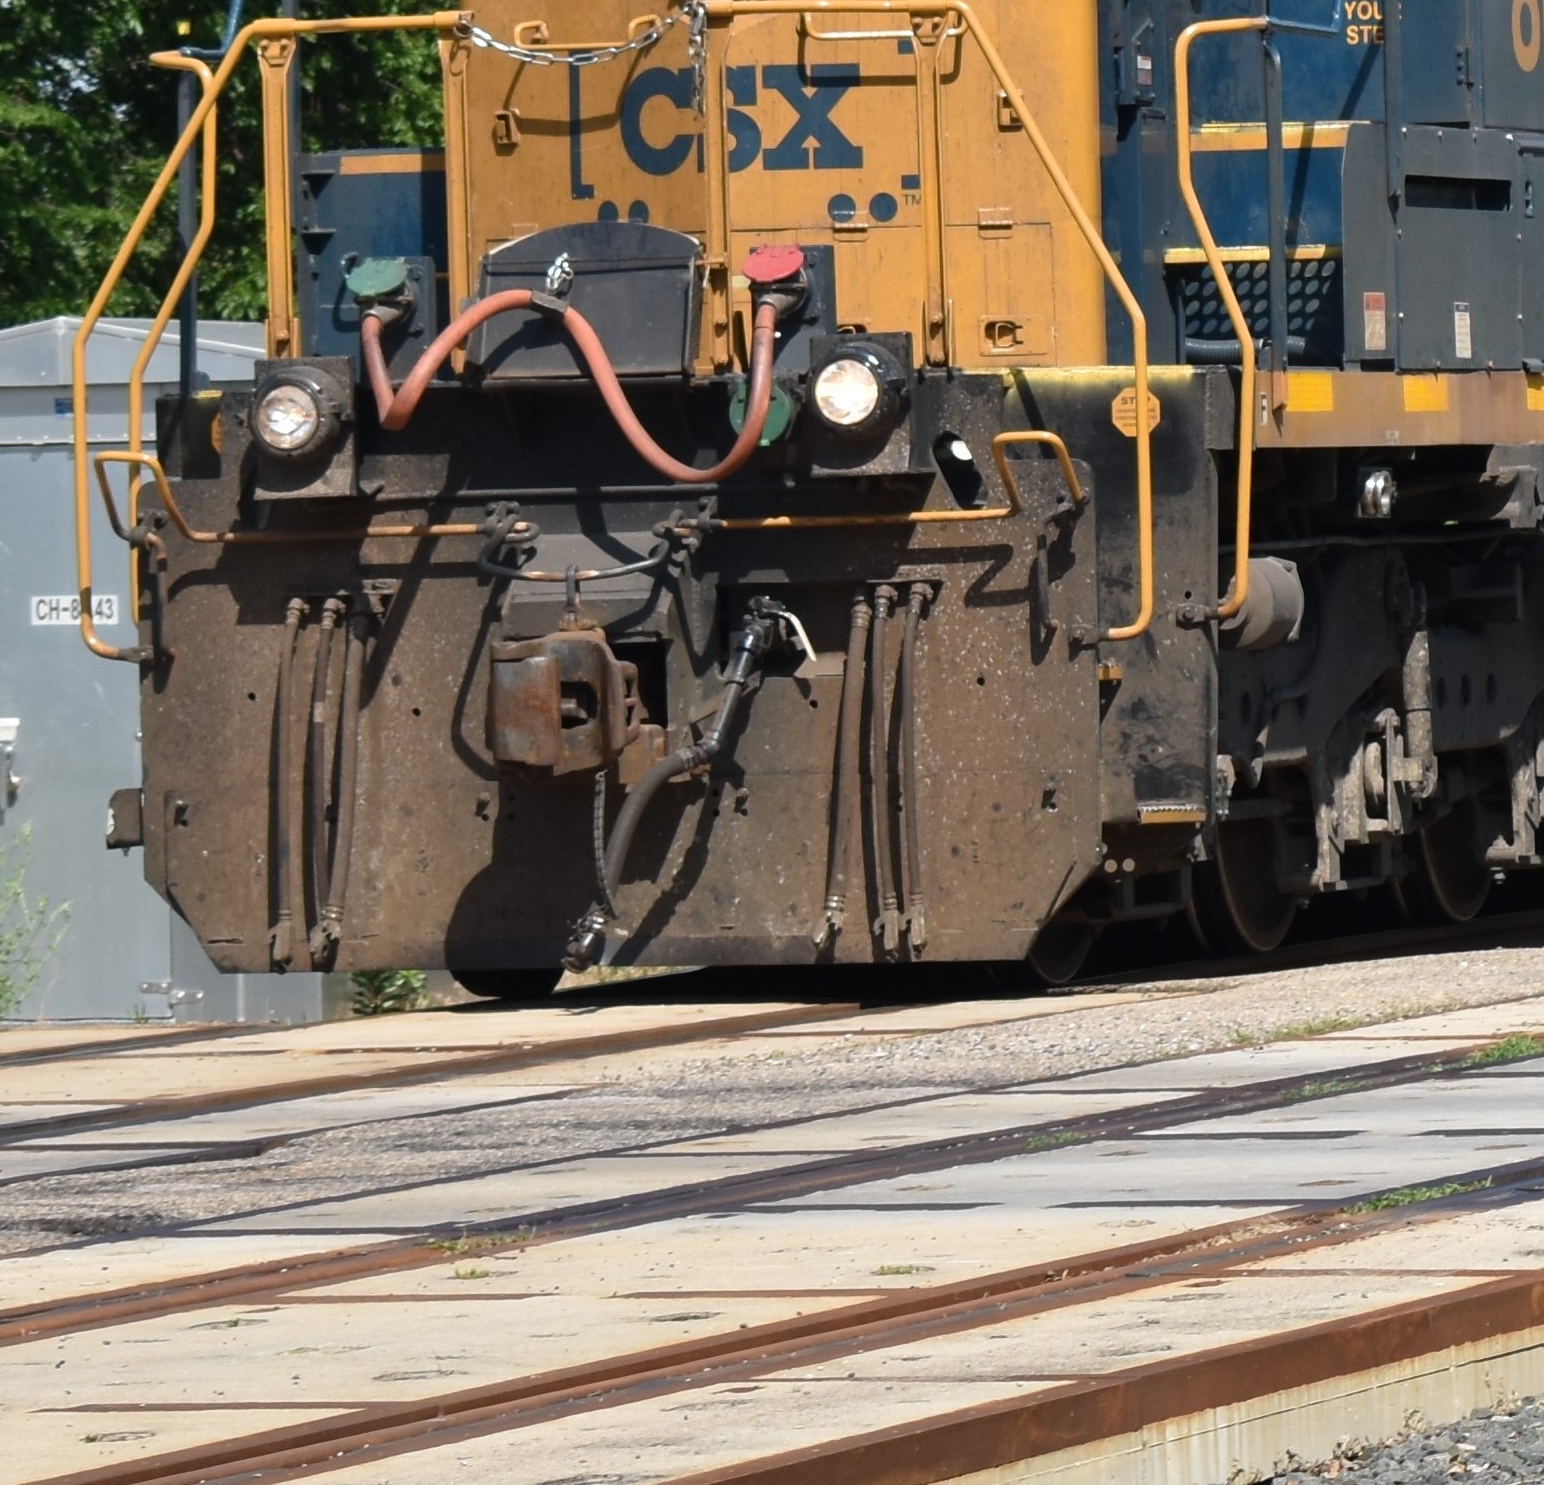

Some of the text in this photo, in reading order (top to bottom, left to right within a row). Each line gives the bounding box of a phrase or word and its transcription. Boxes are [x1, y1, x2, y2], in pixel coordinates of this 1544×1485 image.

[1344, 0, 1402, 21] YOU
[1346, 24, 1384, 46] STE
[619, 63, 864, 176] CSX
[36, 598, 113, 620] CH-843
